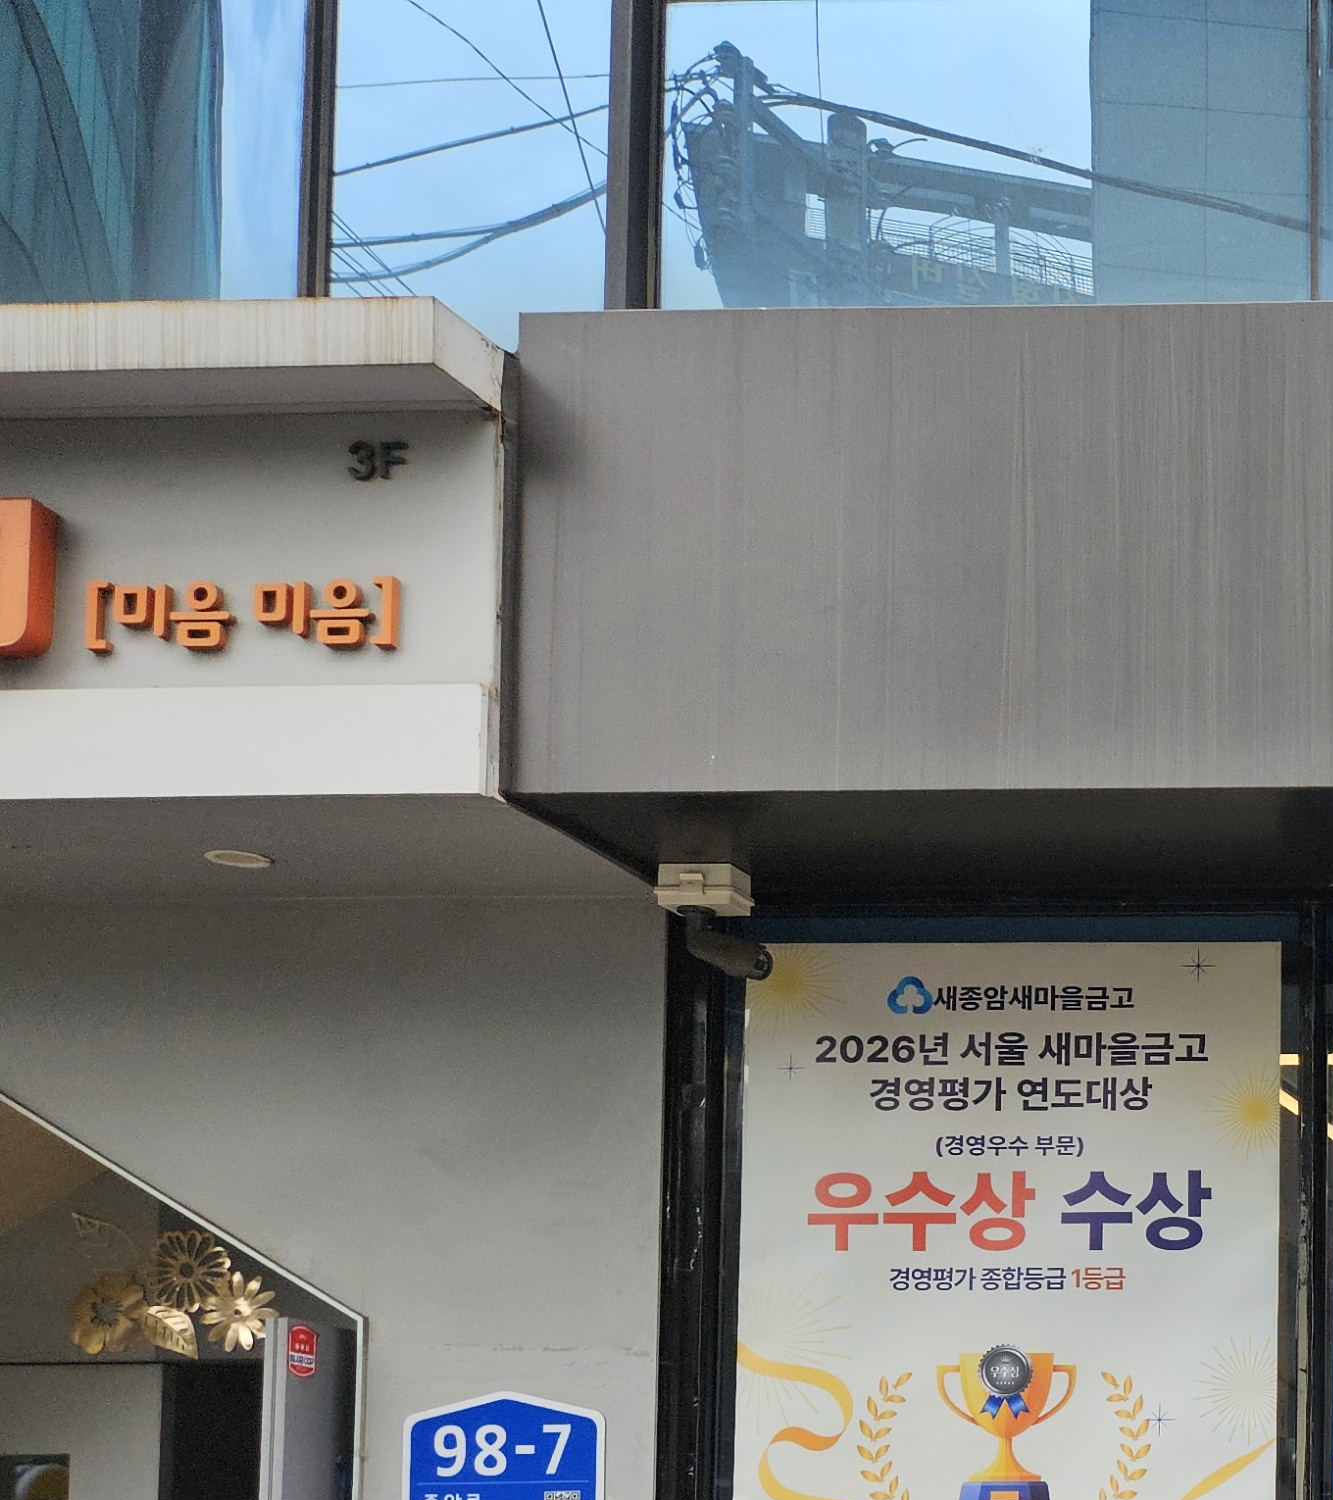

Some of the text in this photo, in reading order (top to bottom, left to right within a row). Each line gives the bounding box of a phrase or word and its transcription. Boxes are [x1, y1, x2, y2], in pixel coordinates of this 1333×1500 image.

[348, 440, 408, 481] 3F
[933, 984, 1135, 1012] 새종암새마을금고
[815, 1031, 1209, 1067] 2026년 서울 새마을금고
[869, 1076, 1153, 1112] 경영평가 연도대상
[935, 1134, 1084, 1158] (경영우수 부문)
[807, 1169, 1213, 1252] 우수상 수상
[889, 1266, 1126, 1292] 경영평가 종합등급 1등급
[433, 1423, 572, 1478] 98-7
